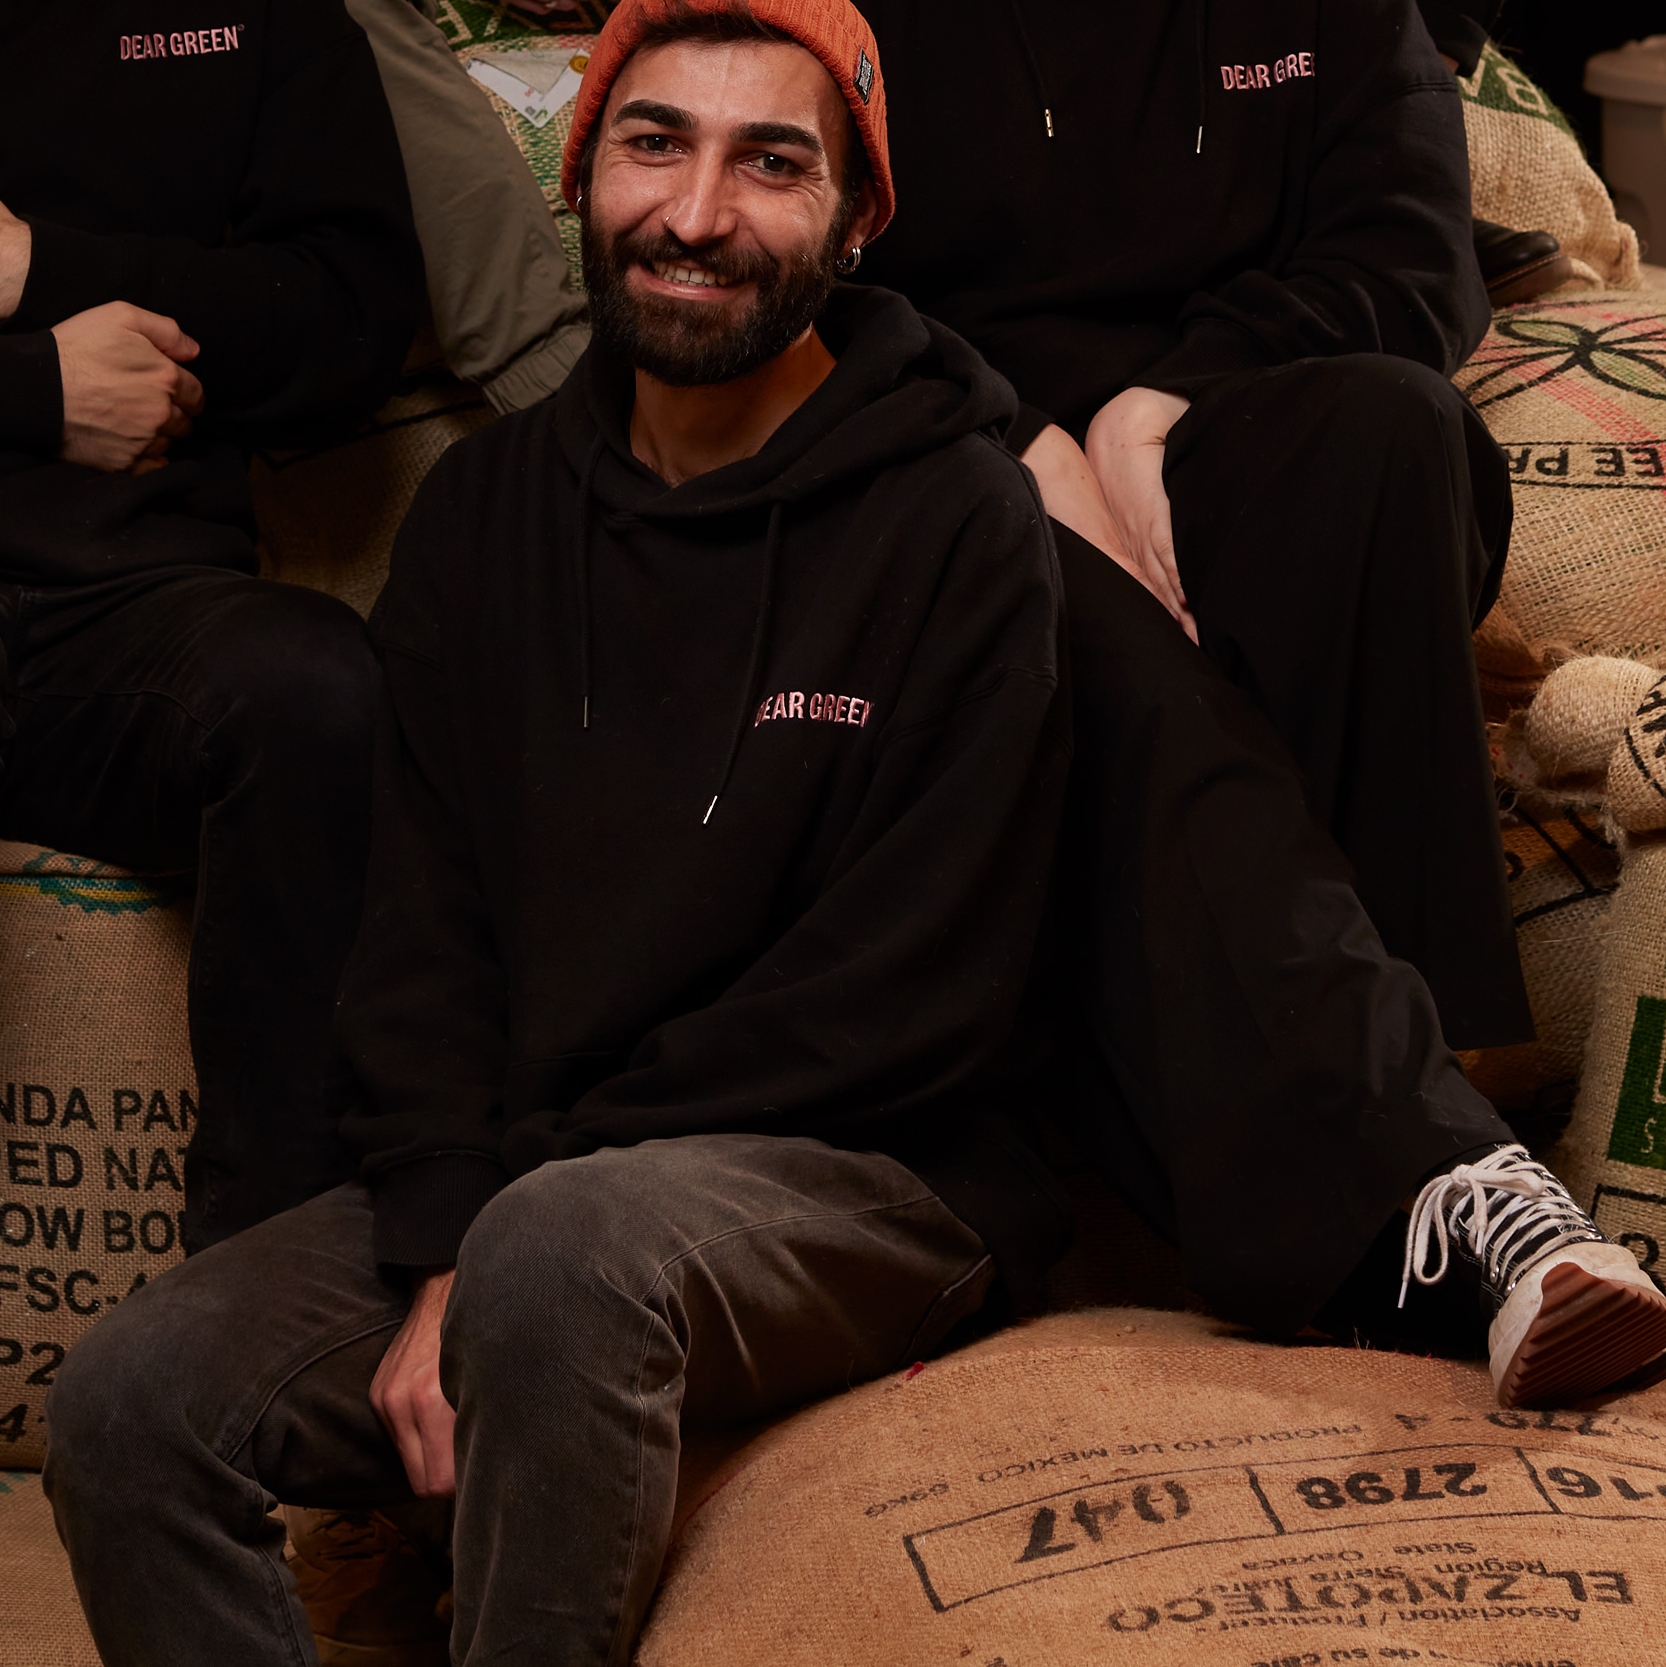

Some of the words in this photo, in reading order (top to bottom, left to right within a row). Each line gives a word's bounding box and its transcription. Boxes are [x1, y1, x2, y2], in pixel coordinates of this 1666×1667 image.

[119, 33, 168, 61] DEAR
[169, 25, 239, 56] GREEN
[1220, 63, 1272, 90] DEAR
[809, 692, 875, 728] GREEN
[103, 1146, 187, 1192] NA
[1173, 1425, 1363, 1454] PRODUCTO
[976, 1447, 1108, 1483] MEXICO
[1295, 1463, 1489, 1511] 2798
[1106, 1574, 1524, 1635] ZAPOTECO
[1541, 1570, 1635, 1606] EL
[1397, 1605, 1582, 1624] Association
